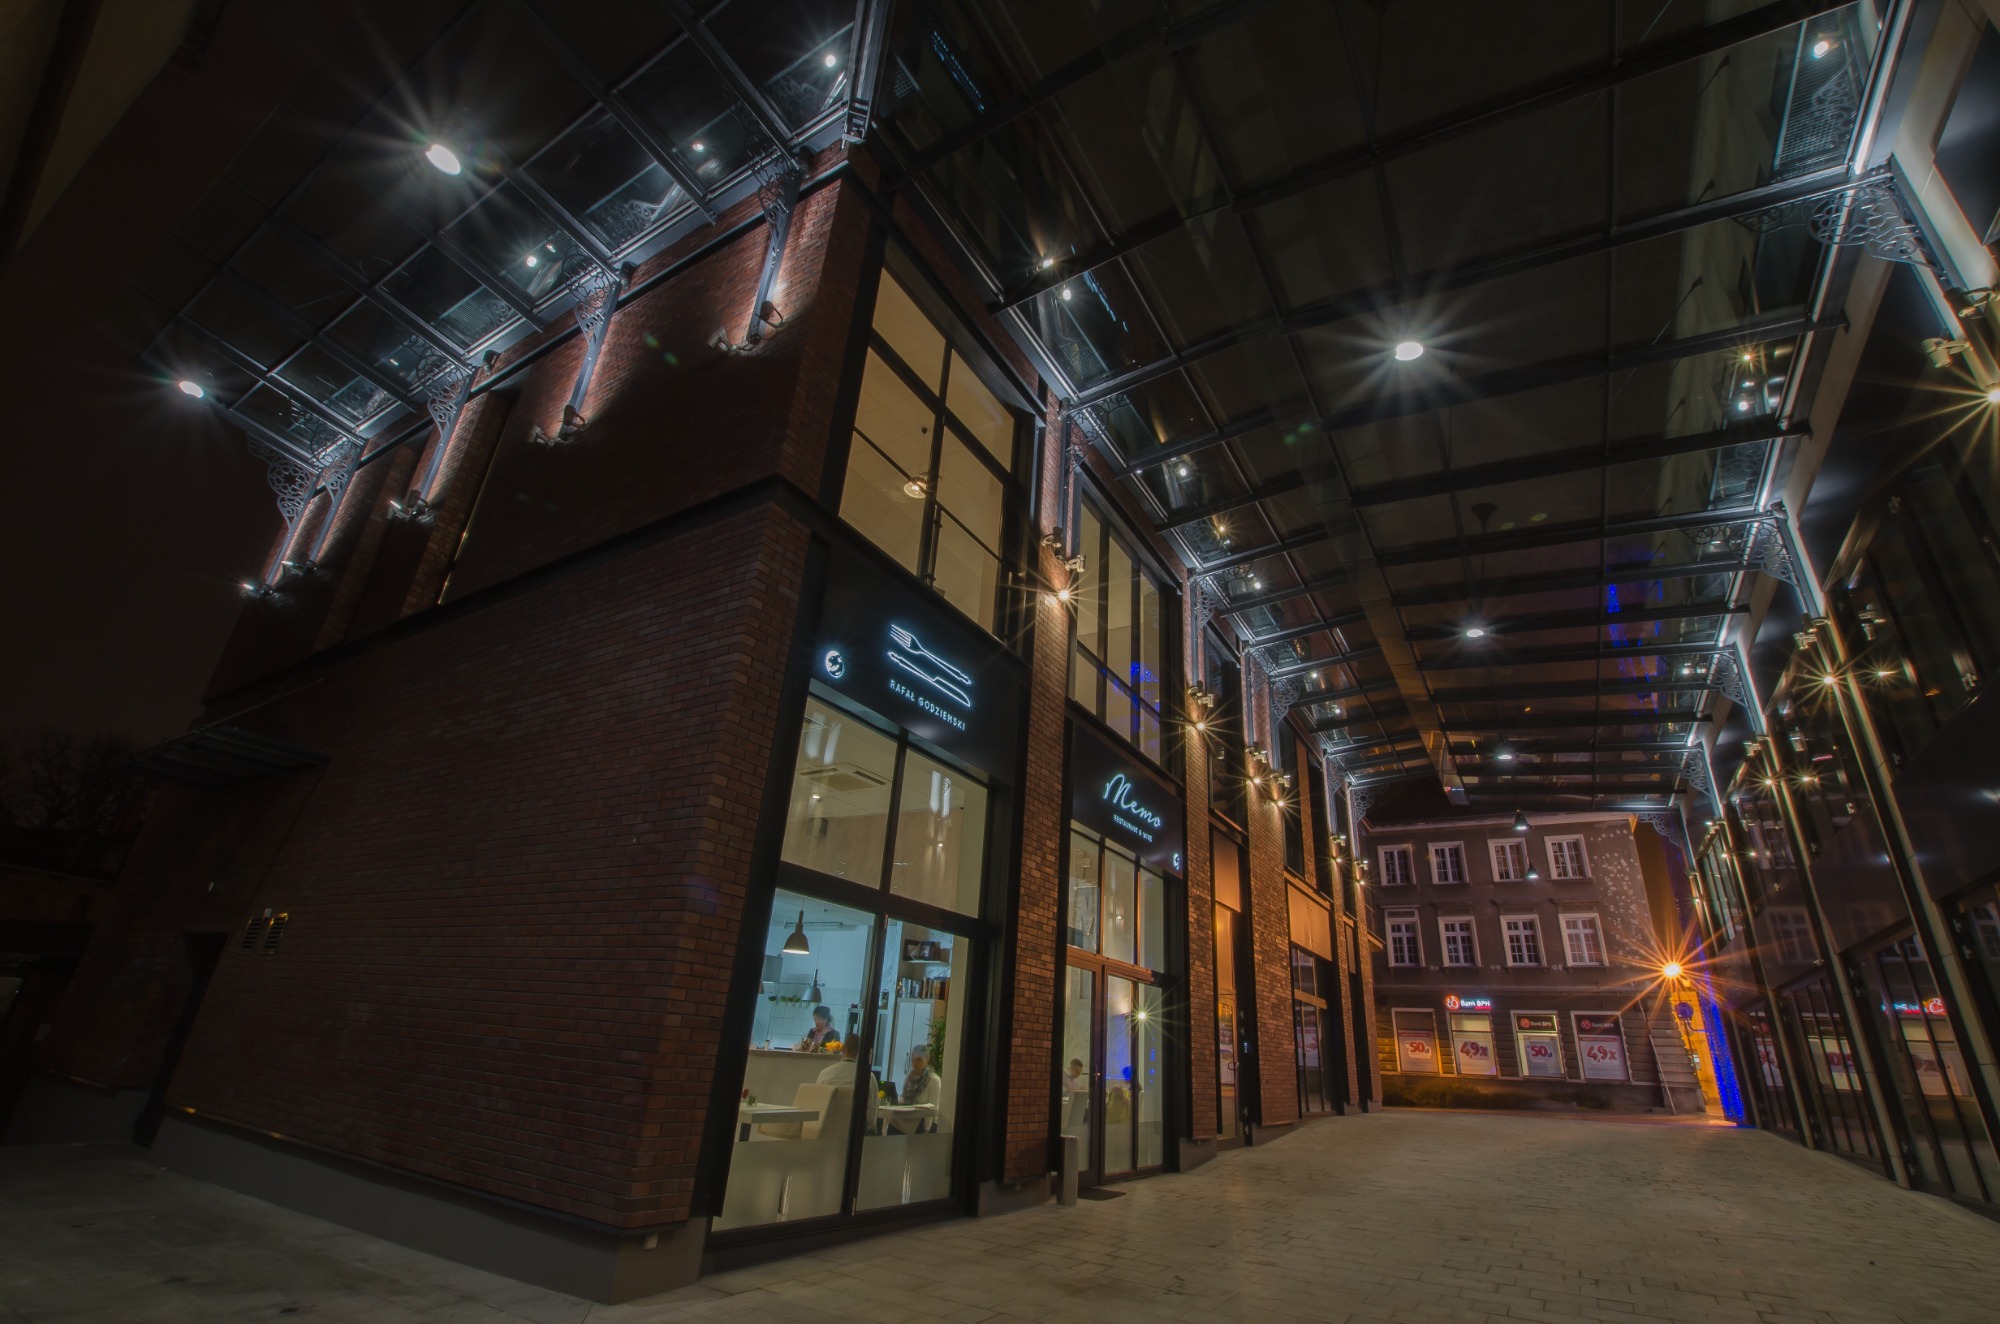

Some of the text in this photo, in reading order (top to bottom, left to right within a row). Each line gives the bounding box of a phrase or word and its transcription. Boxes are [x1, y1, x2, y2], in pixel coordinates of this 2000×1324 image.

[890, 679, 966, 731] RAFAŁ GODZIEMSKI
[1102, 773, 1162, 828] Memo
[1113, 814, 1139, 834] RESTAURANT
[1460, 999, 1490, 1008] Bank BPH
